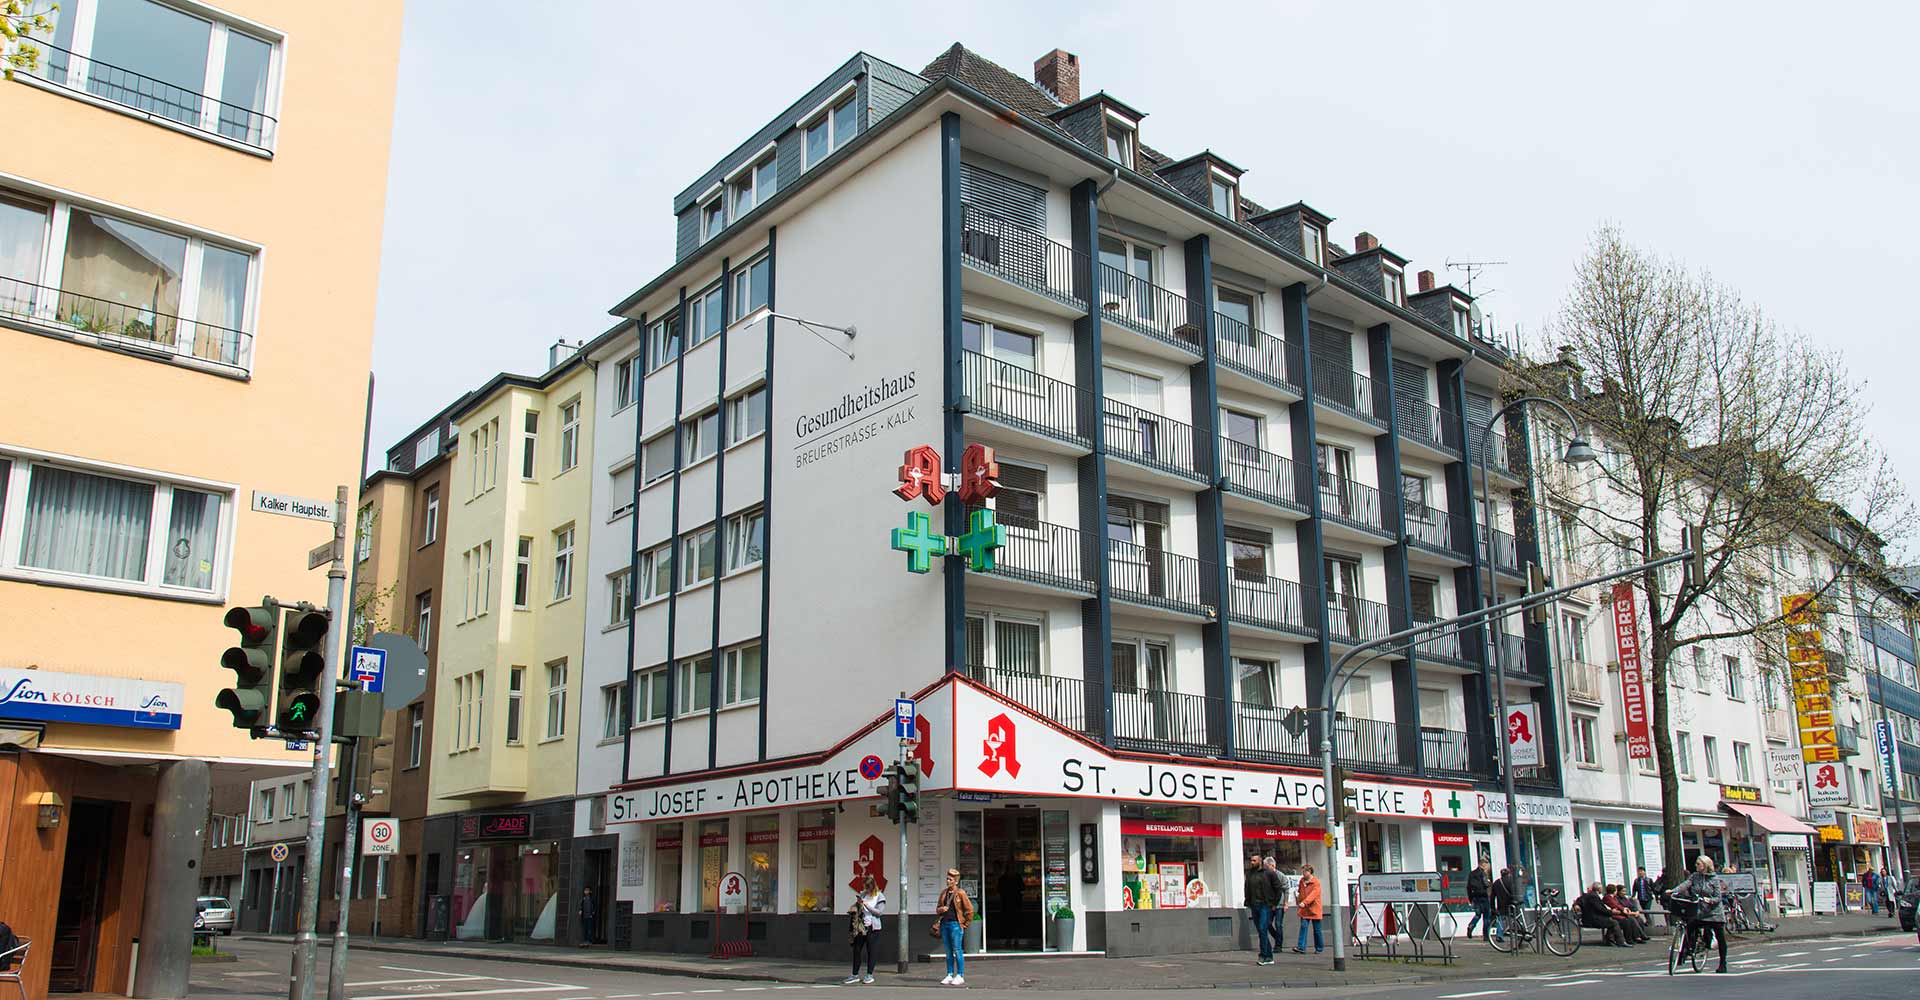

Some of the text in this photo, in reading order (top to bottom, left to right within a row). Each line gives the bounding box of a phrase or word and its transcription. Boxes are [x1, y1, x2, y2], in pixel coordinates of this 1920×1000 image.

[796, 371, 916, 439] Gesundheitshaus
[796, 422, 877, 468] BREUERSTRASSE
[887, 406, 915, 430] KALK
[260, 496, 330, 518] Kalker Hauptstr.
[1617, 599, 1643, 723] MIDDELBERG
[1, 678, 115, 706] Sion KÖLSCH
[139, 694, 168, 709] Sion
[613, 795, 639, 820] ST.
[649, 788, 706, 817] JOSEF
[734, 768, 859, 808] APOTHEKE
[1062, 758, 1117, 795] ST.
[1139, 765, 1235, 802] JOSEF
[1274, 776, 1406, 814] APOHEKE
[375, 827, 388, 838] 30
[1146, 824, 1194, 833] BESTELLHOTLINE
[371, 844, 390, 852] ZONE
